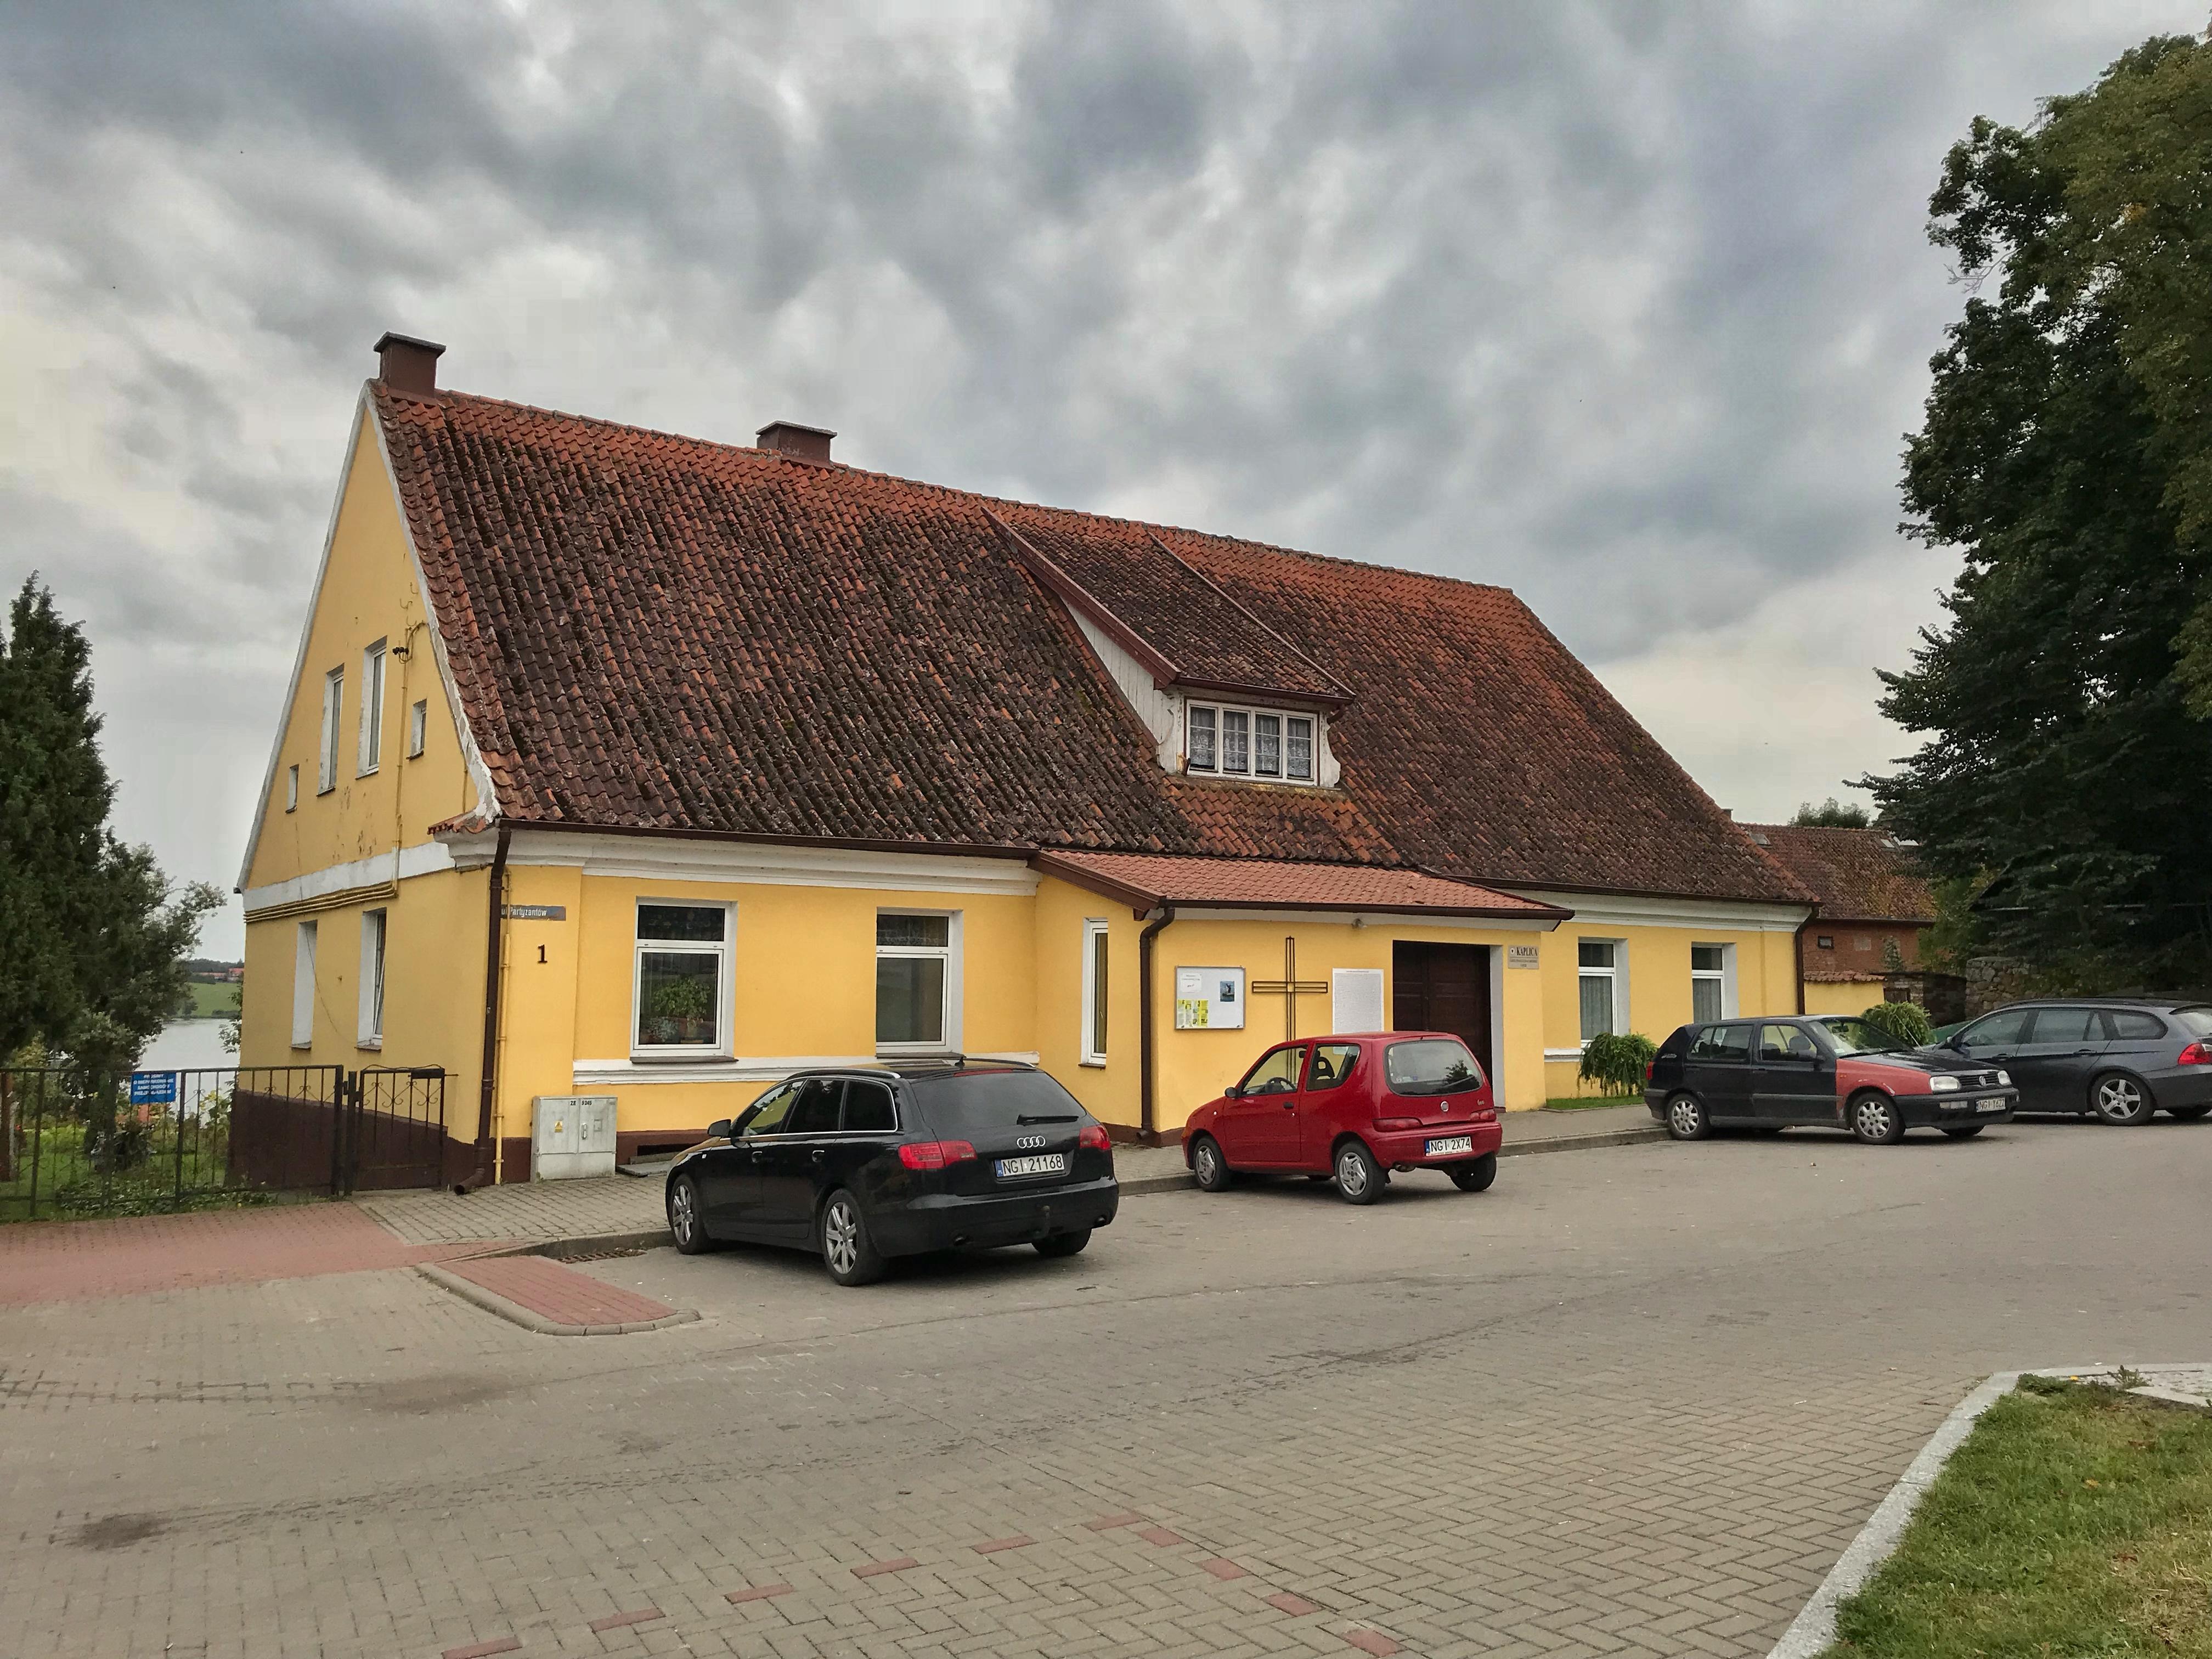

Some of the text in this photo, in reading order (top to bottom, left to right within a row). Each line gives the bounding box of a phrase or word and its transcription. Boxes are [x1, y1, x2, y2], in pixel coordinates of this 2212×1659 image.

[538, 944, 548, 964] 1
[1516, 947, 1538, 956] KAPLICA
[1430, 1137, 1470, 1152] NGI 2X74
[1002, 1155, 1063, 1175] NGI 21168
